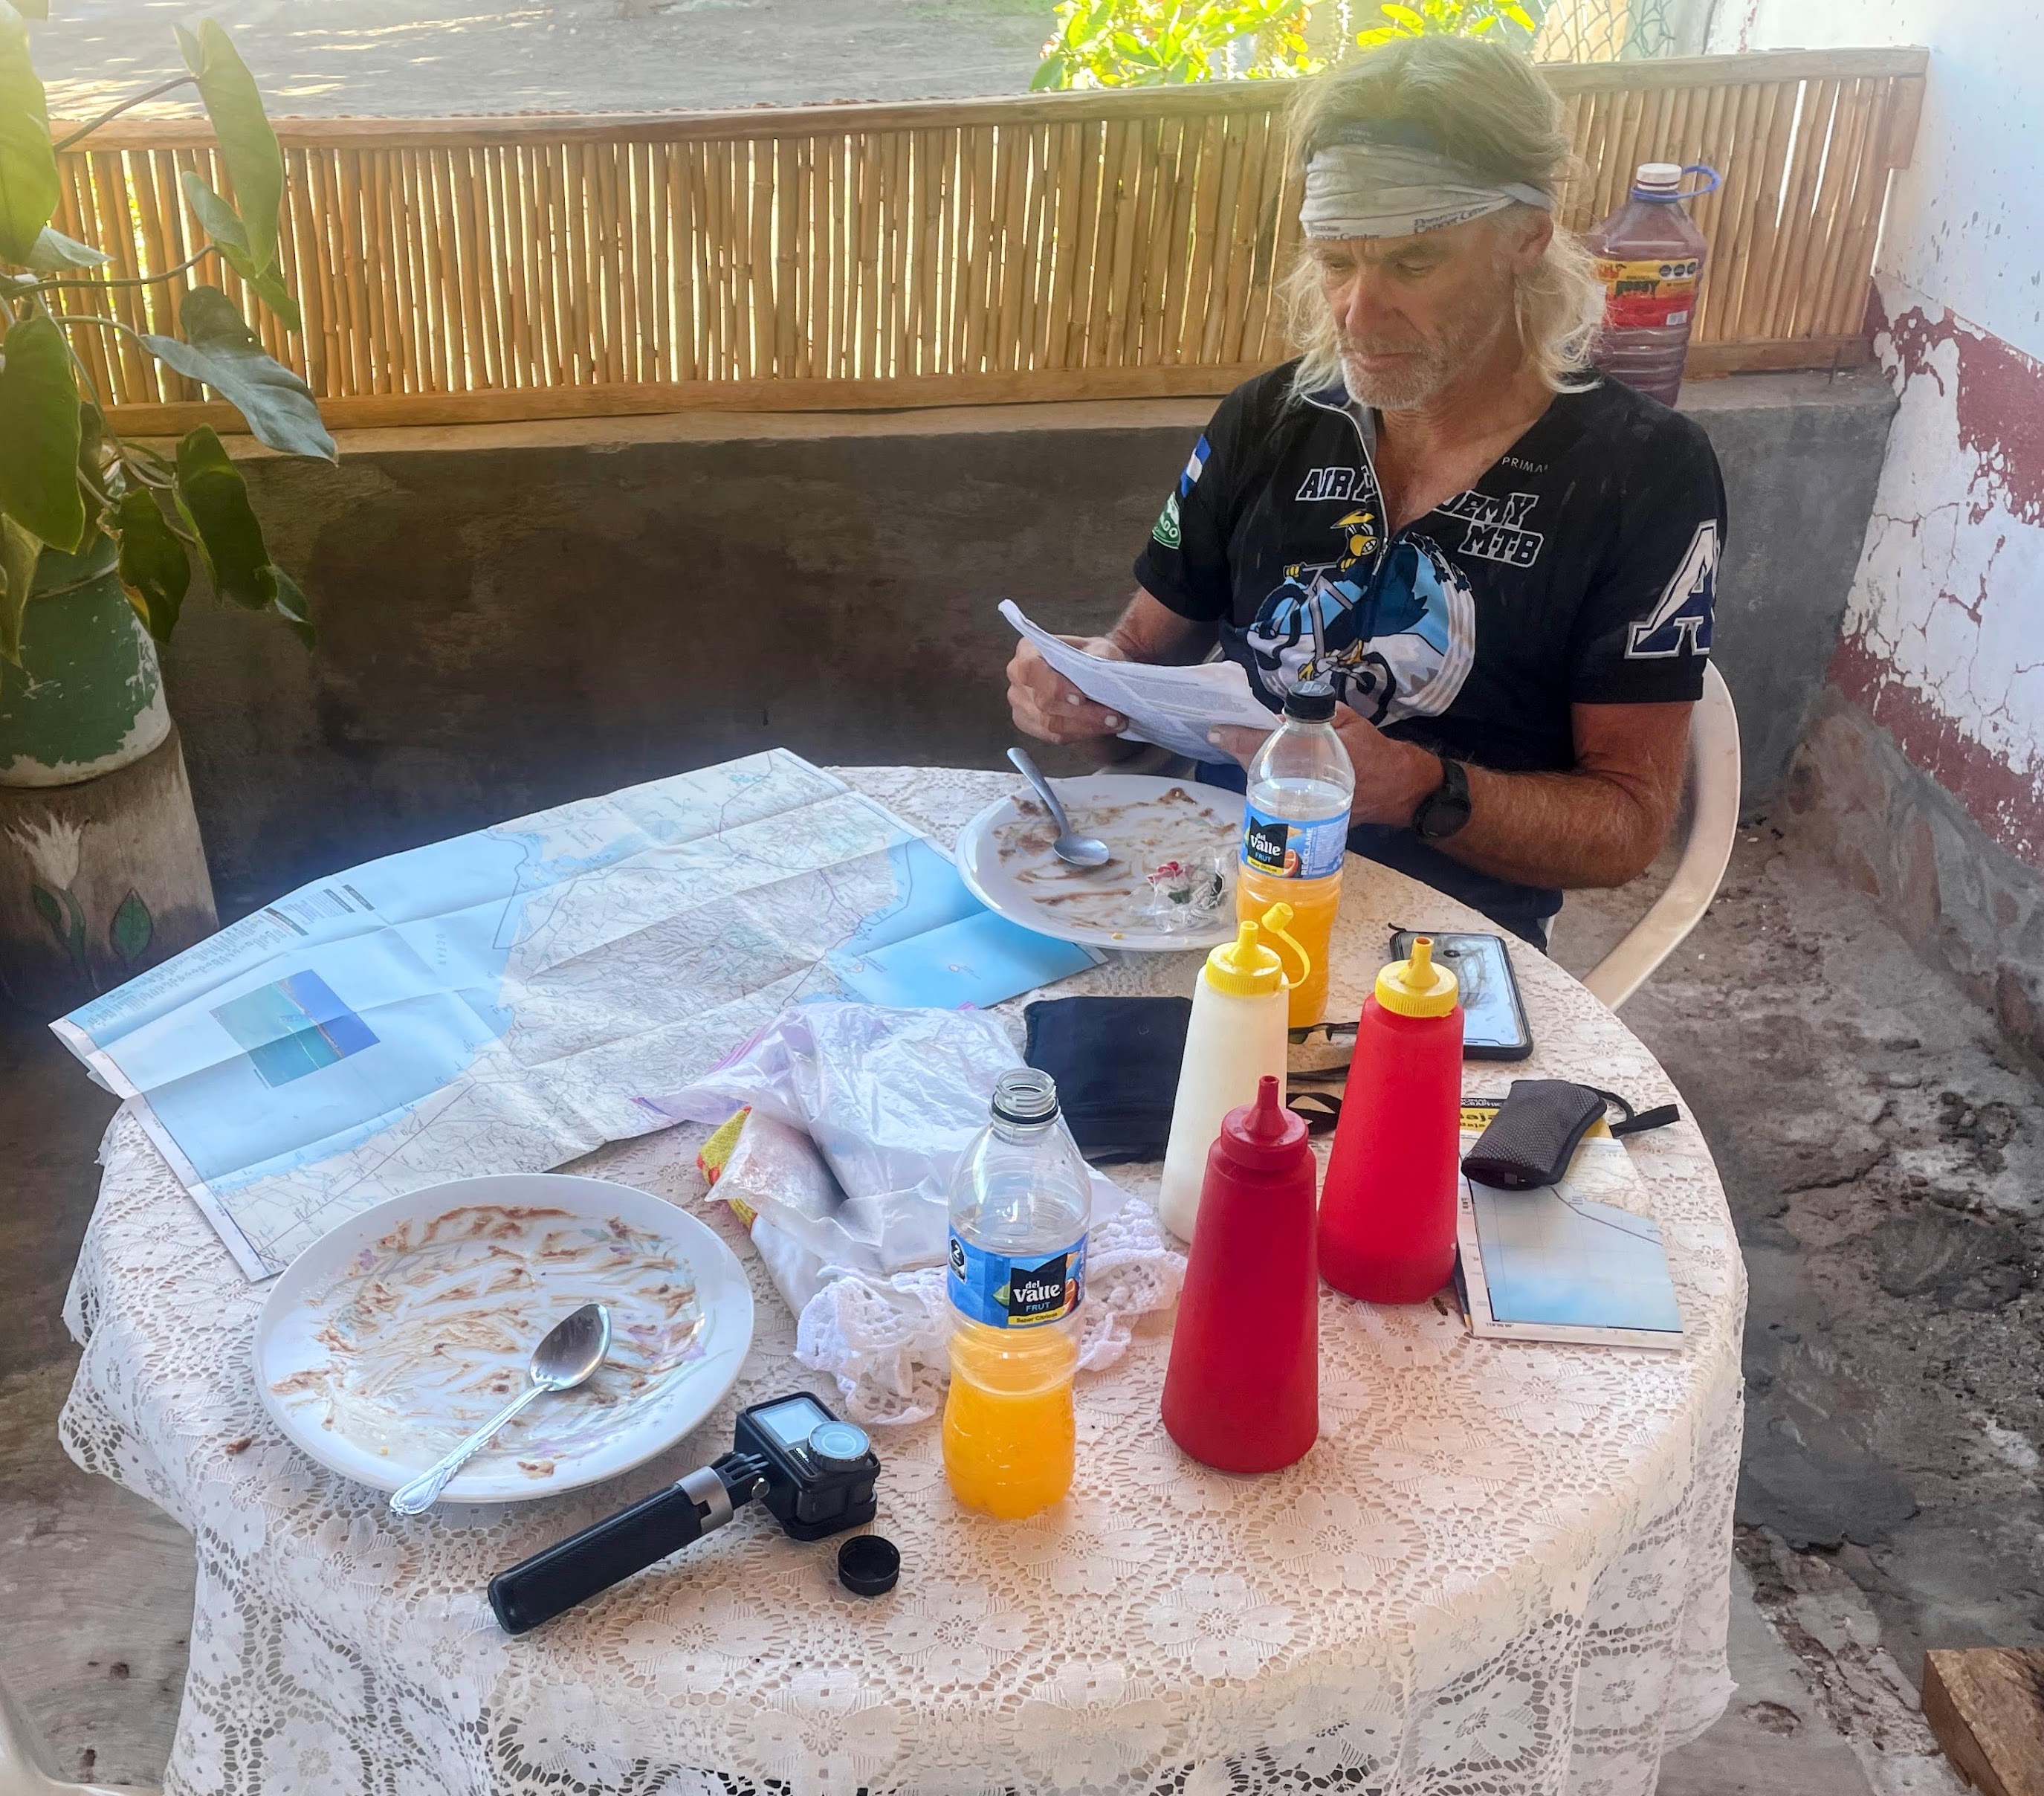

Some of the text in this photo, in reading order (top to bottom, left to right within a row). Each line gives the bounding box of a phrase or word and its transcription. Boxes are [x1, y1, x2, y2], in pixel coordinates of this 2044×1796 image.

[1295, 466, 1356, 502] AIR
[1458, 521, 1545, 568] MTB
[1624, 518, 1721, 659] A
[1255, 831, 1267, 841] del
[1249, 834, 1282, 856] Valle
[1255, 851, 1272, 863] FRUT
[953, 1244, 961, 1258] 2
[1012, 1283, 1061, 1303] Valle
[1025, 1279, 1041, 1290] del
[1026, 1302, 1051, 1313] FRUT
